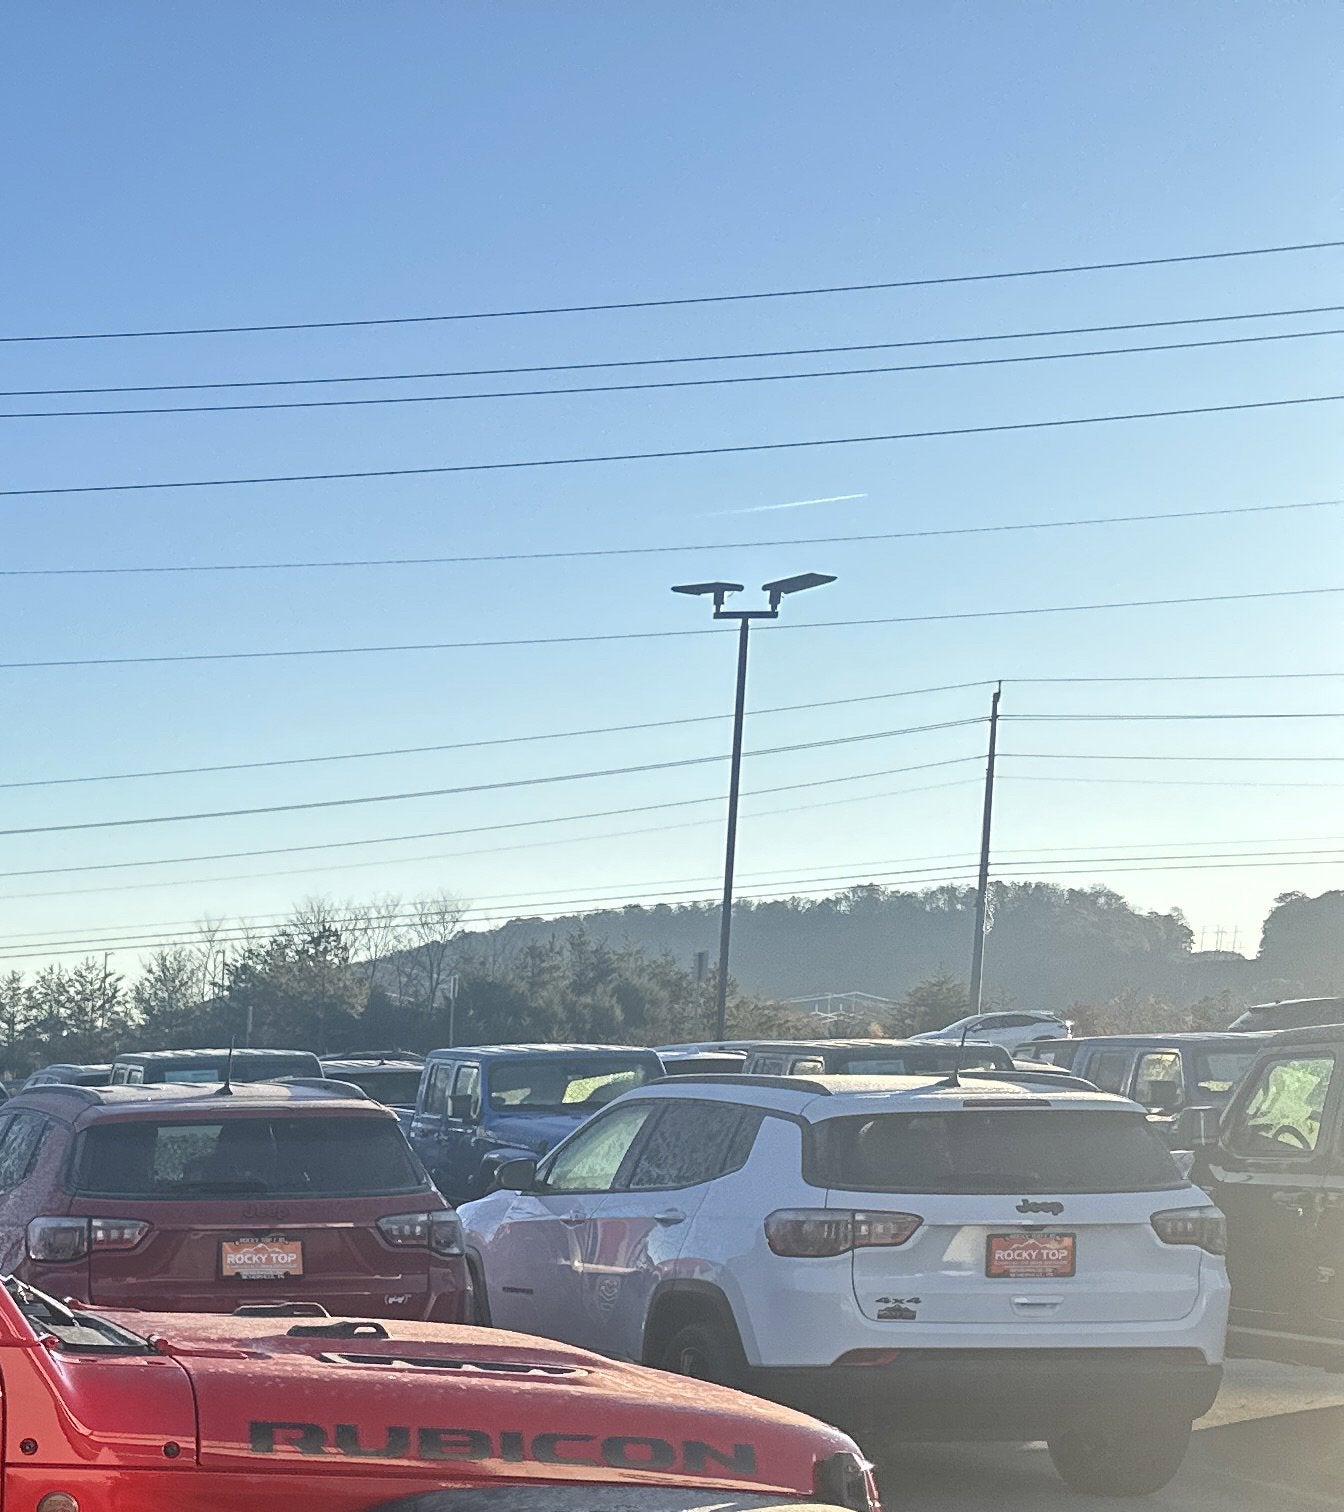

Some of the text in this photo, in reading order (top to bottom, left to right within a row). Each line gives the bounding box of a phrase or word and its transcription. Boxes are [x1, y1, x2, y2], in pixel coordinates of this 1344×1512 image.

[1015, 1198, 1064, 1216] Jeep
[226, 1253, 297, 1264] ROCKY TOP
[994, 1249, 1068, 1260] ROCKY TOP
[248, 1420, 757, 1475] RUBICON
